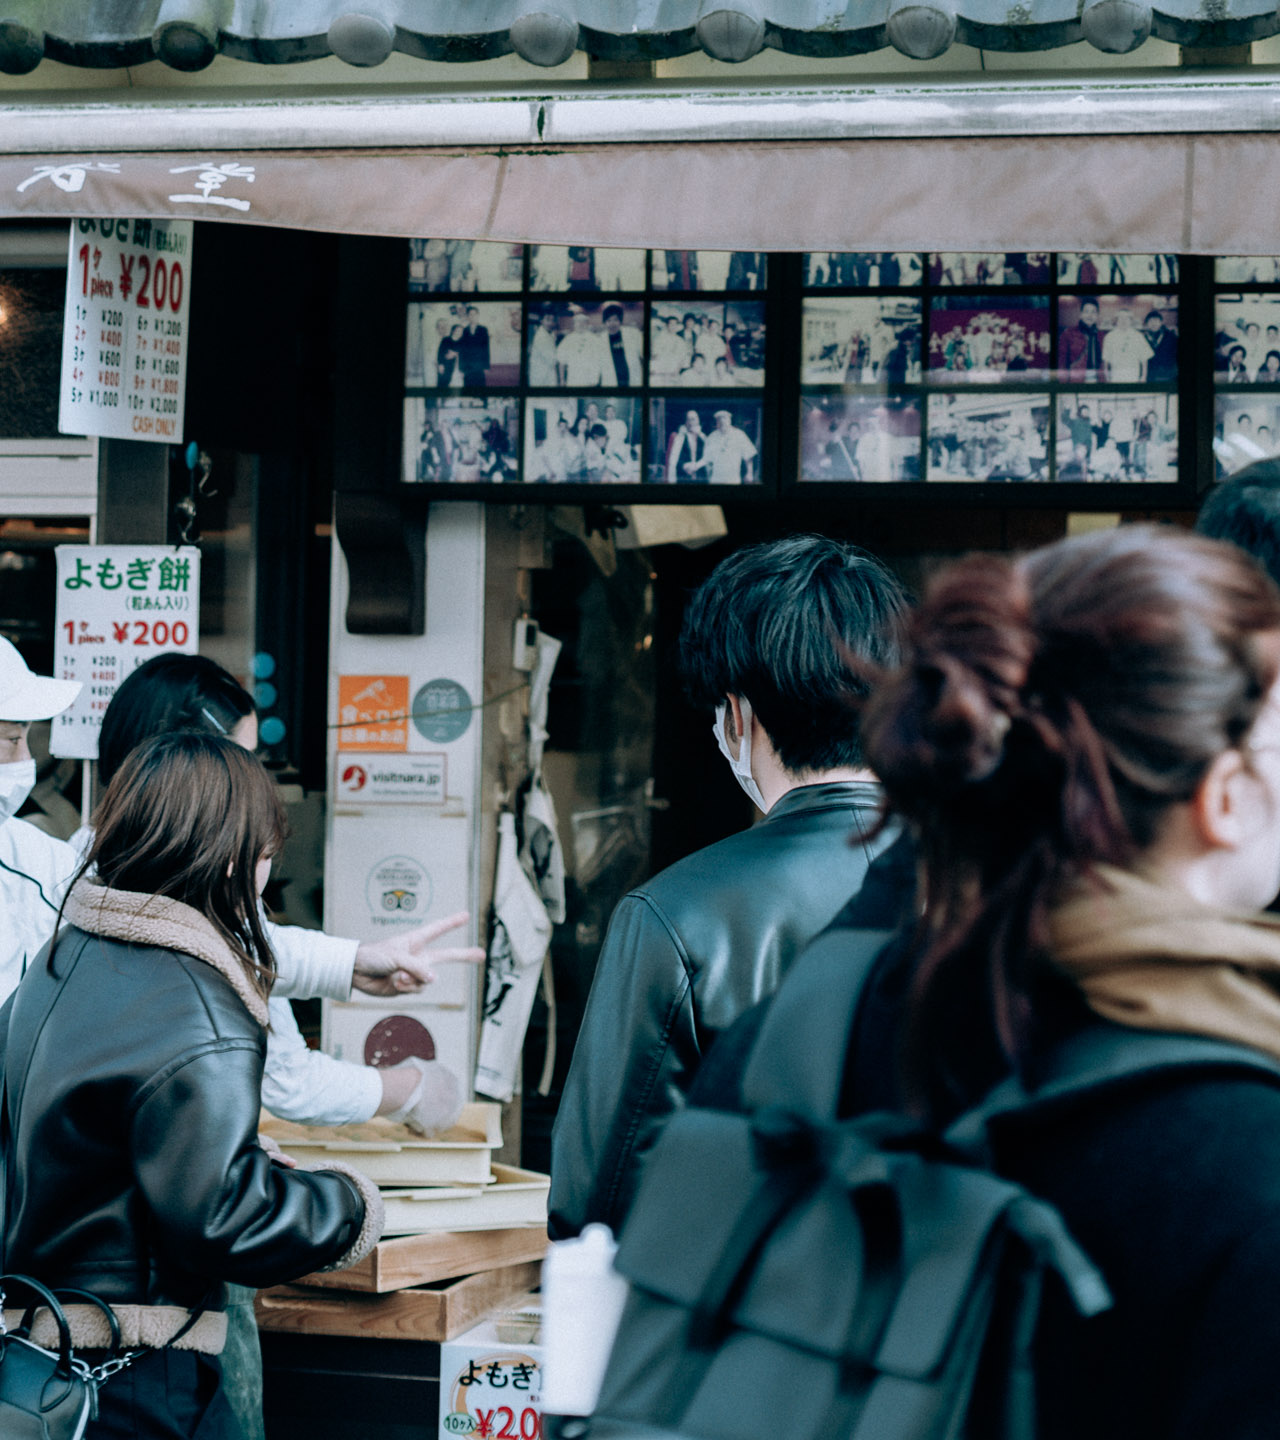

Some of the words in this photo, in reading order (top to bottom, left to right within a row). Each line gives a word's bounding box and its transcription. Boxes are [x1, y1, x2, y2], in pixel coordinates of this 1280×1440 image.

[120, 253, 183, 314] ¥200
[64, 556, 190, 592] よもぎ餅
[112, 621, 189, 646] ¥200
[459, 1359, 542, 1390] よもぎ
[475, 1406, 543, 1440] ¥2,0
